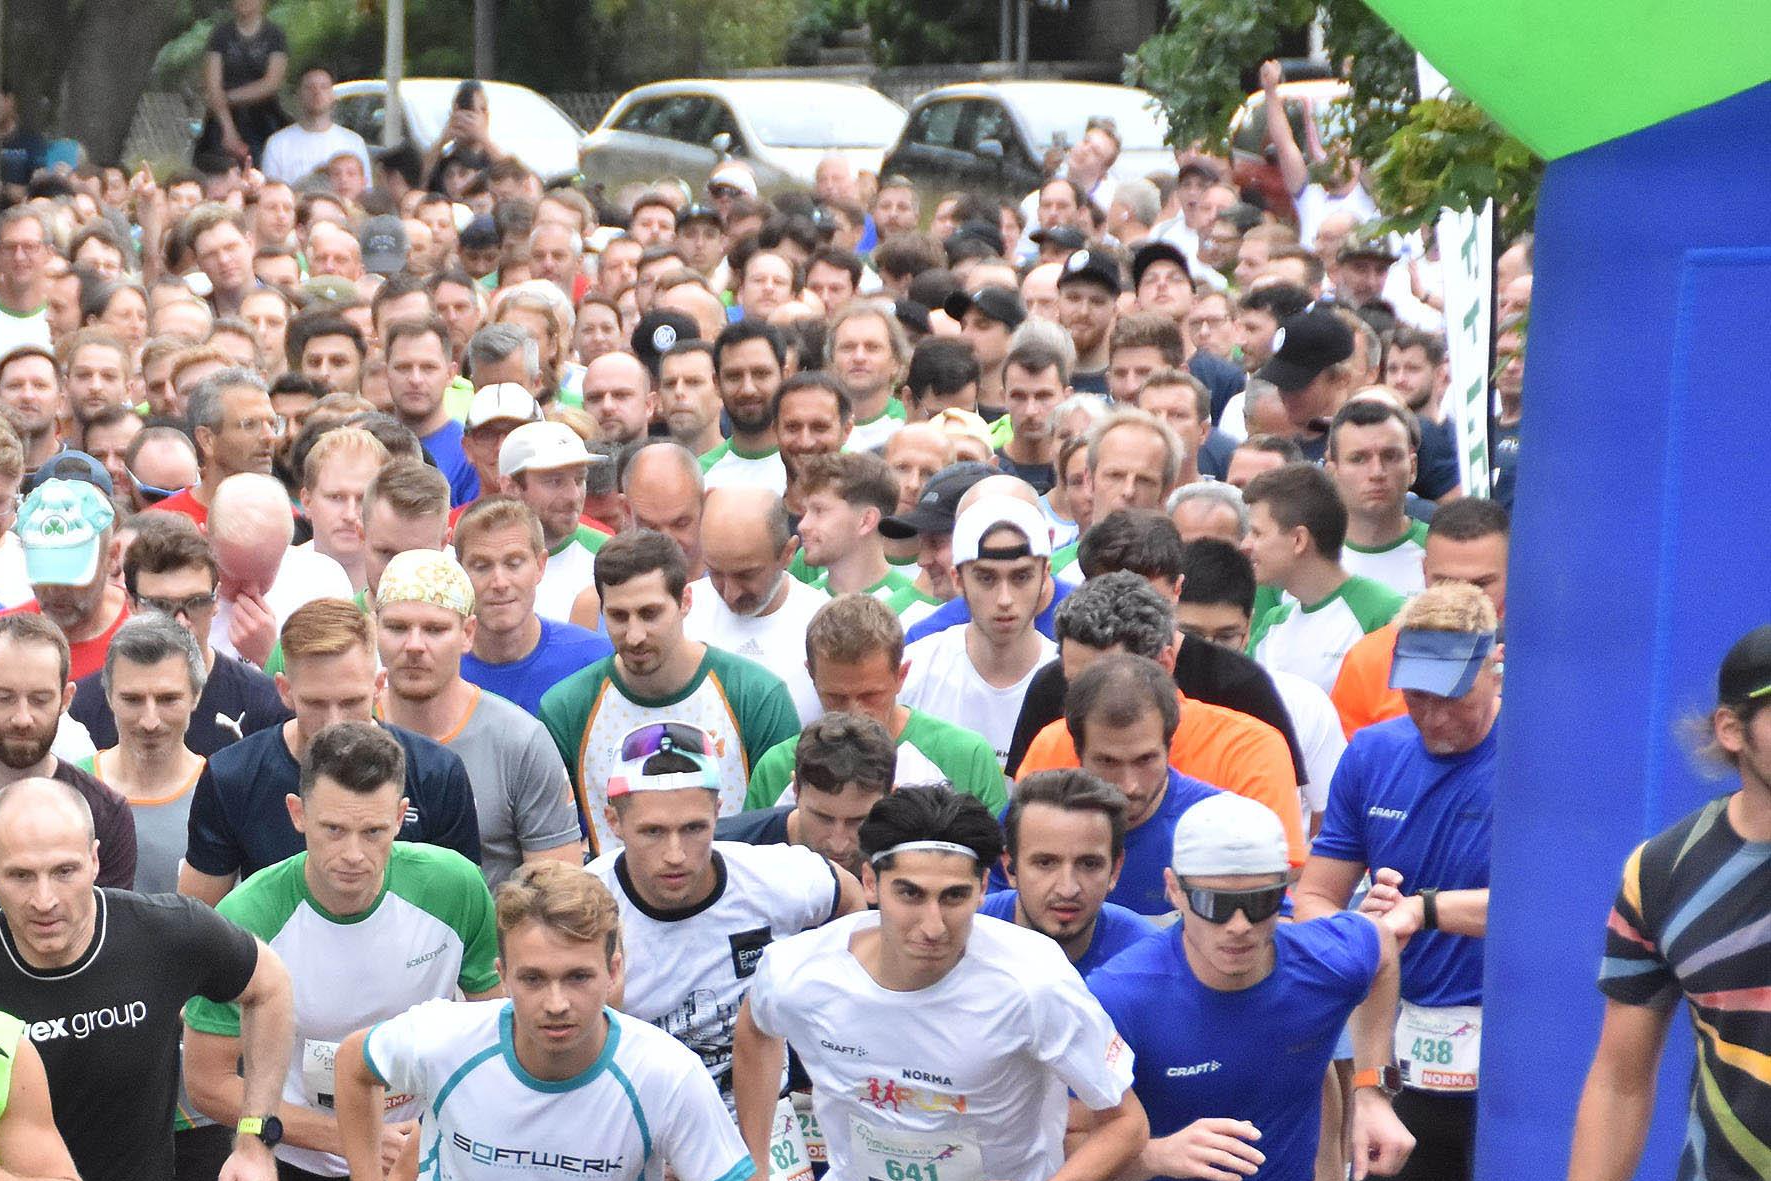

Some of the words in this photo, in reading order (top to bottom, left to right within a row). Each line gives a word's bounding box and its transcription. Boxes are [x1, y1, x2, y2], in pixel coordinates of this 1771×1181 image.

[71, 1000, 147, 1039] group
[821, 1039, 856, 1055] CRAFT
[1411, 1037, 1453, 1065] 438
[902, 1068, 953, 1086] NORMA
[1167, 1063, 1210, 1077] CRAFT
[1423, 1072, 1474, 1086] NORMA
[453, 1132, 624, 1173] SOFTWERK
